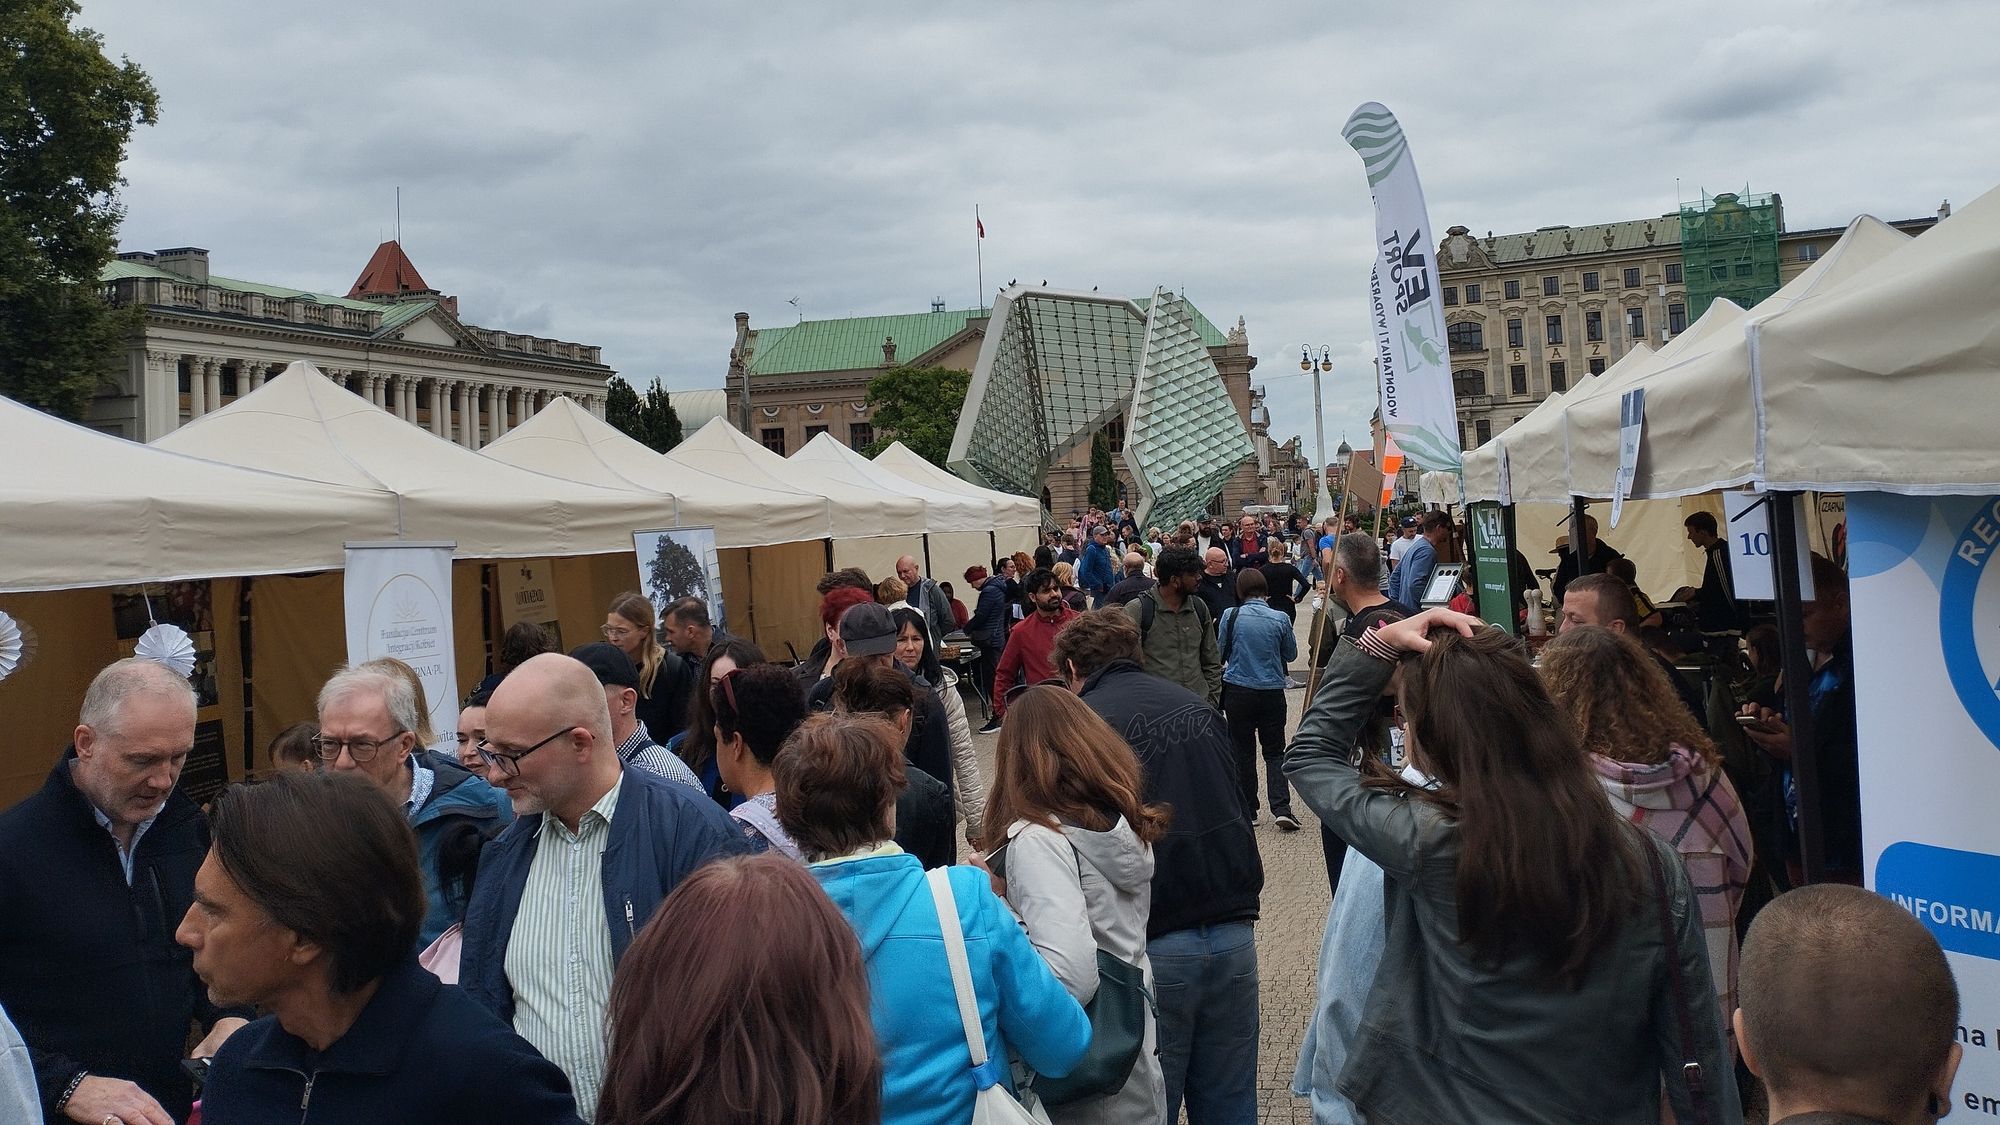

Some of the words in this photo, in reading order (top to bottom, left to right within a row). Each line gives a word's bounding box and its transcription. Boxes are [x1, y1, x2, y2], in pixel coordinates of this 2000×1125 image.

[1489, 535, 1506, 549] SPOR
[1740, 532, 1770, 556] 10
[1891, 892, 2000, 935] INFORM
